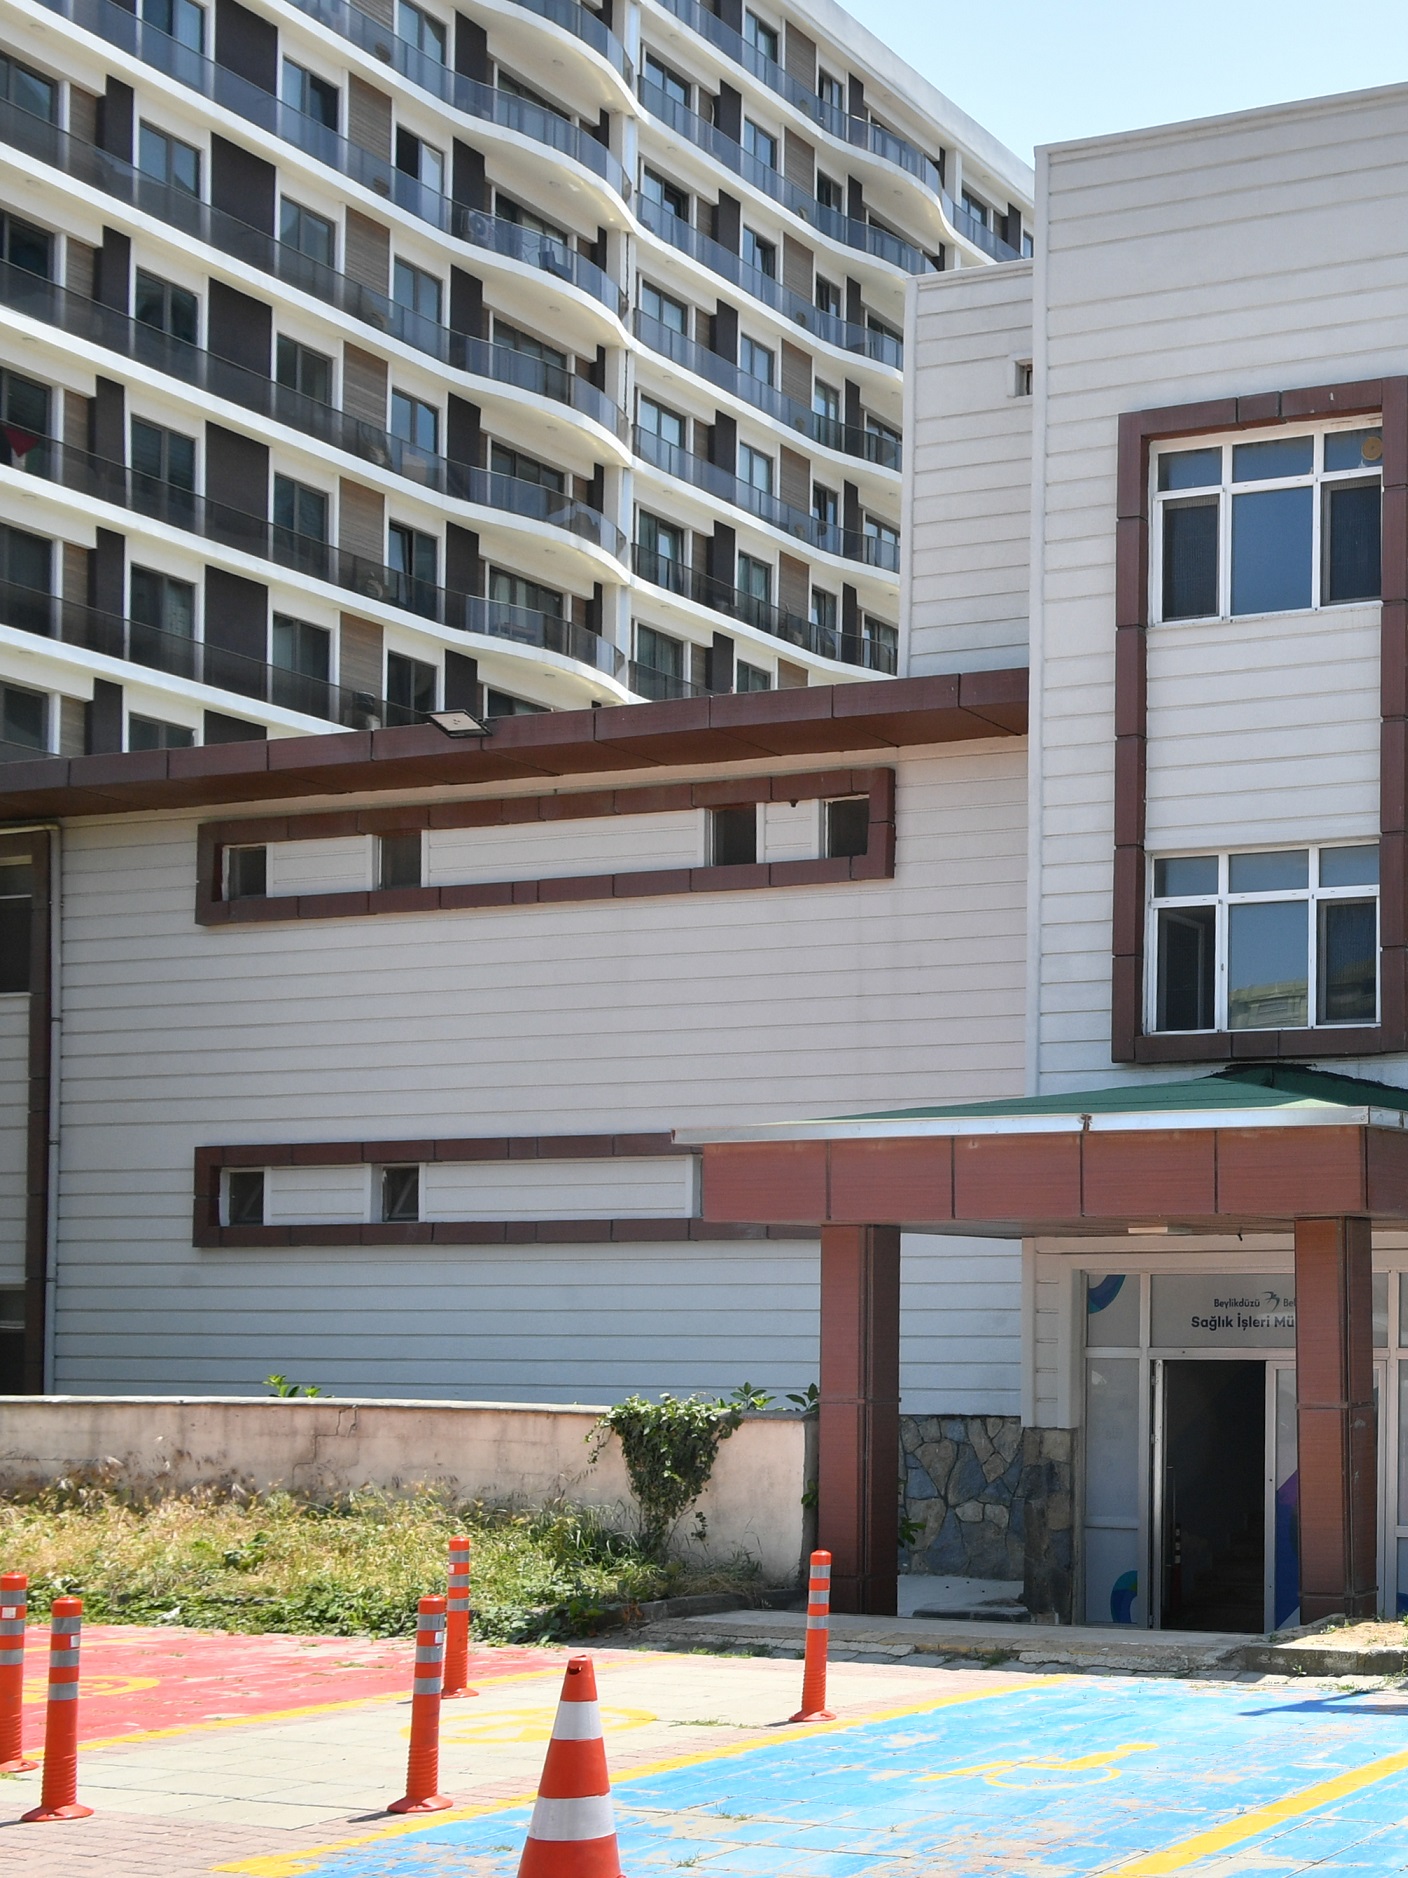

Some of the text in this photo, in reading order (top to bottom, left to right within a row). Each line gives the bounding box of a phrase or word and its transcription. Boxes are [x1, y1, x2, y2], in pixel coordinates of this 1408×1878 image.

[1214, 1298, 1260, 1309] Beylikdüzü
[1191, 1316, 1233, 1331] Sağlık
[1237, 1313, 1270, 1331] İşleri
